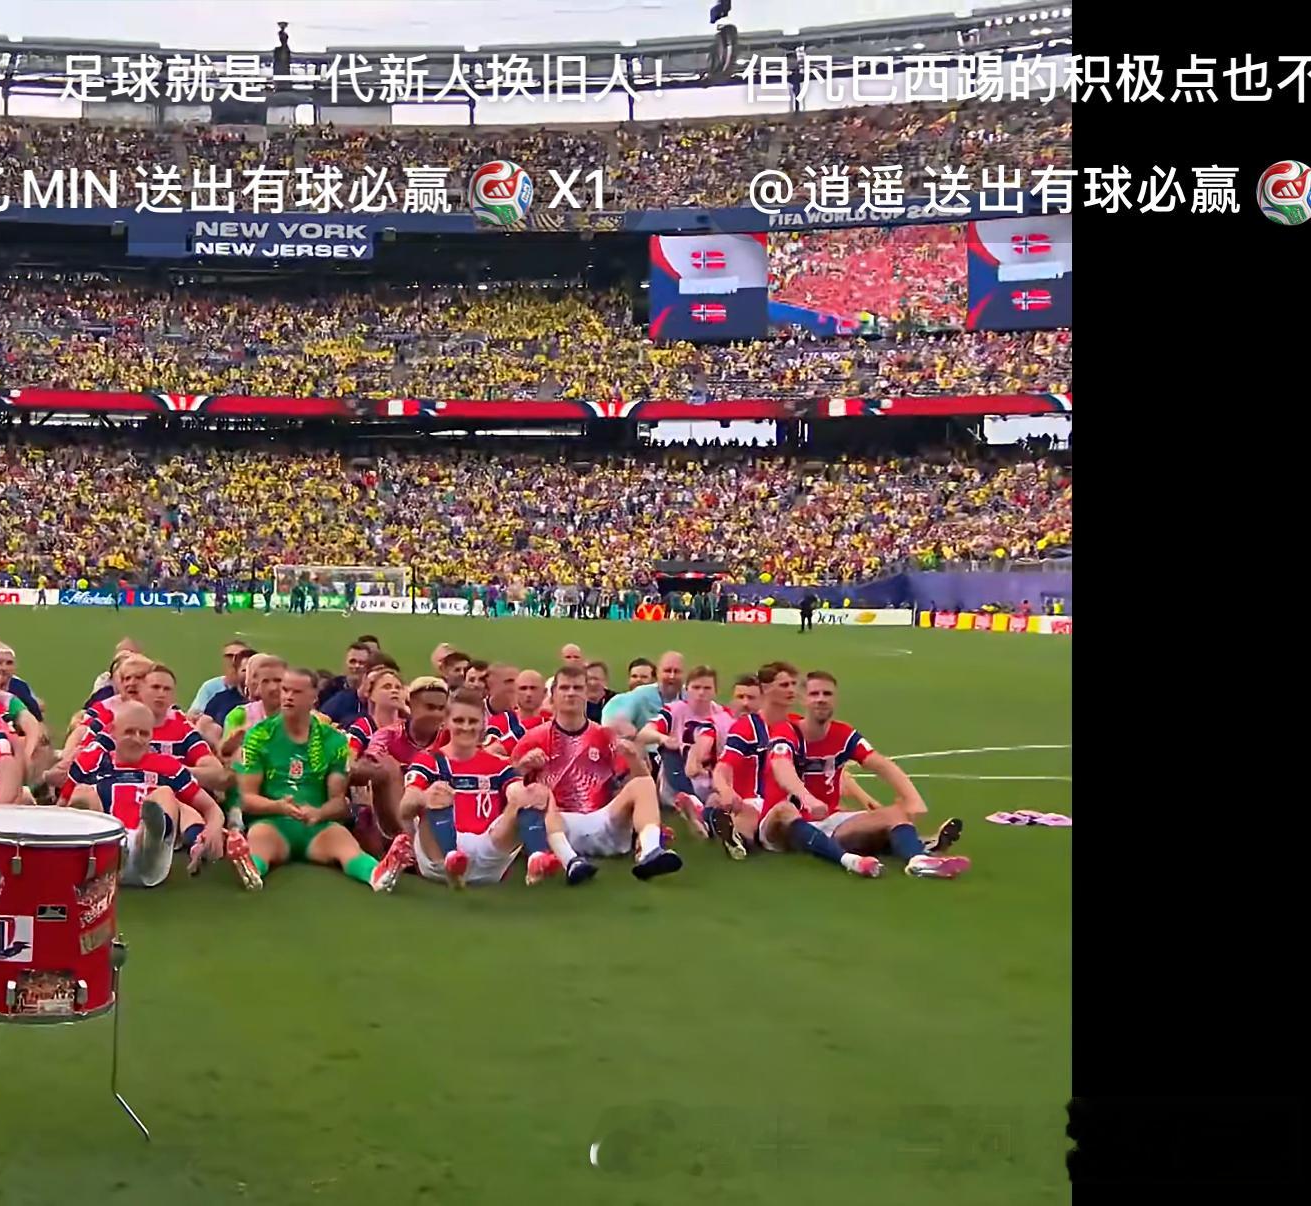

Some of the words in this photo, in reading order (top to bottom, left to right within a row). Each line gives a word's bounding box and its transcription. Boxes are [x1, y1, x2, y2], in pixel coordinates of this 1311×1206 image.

[769, 212, 804, 227] FIFA
[194, 221, 267, 239] NEW
[277, 222, 368, 240] YORK
[194, 242, 256, 256] NEW
[262, 242, 368, 259] JERSEY
[475, 790, 493, 818] 10
